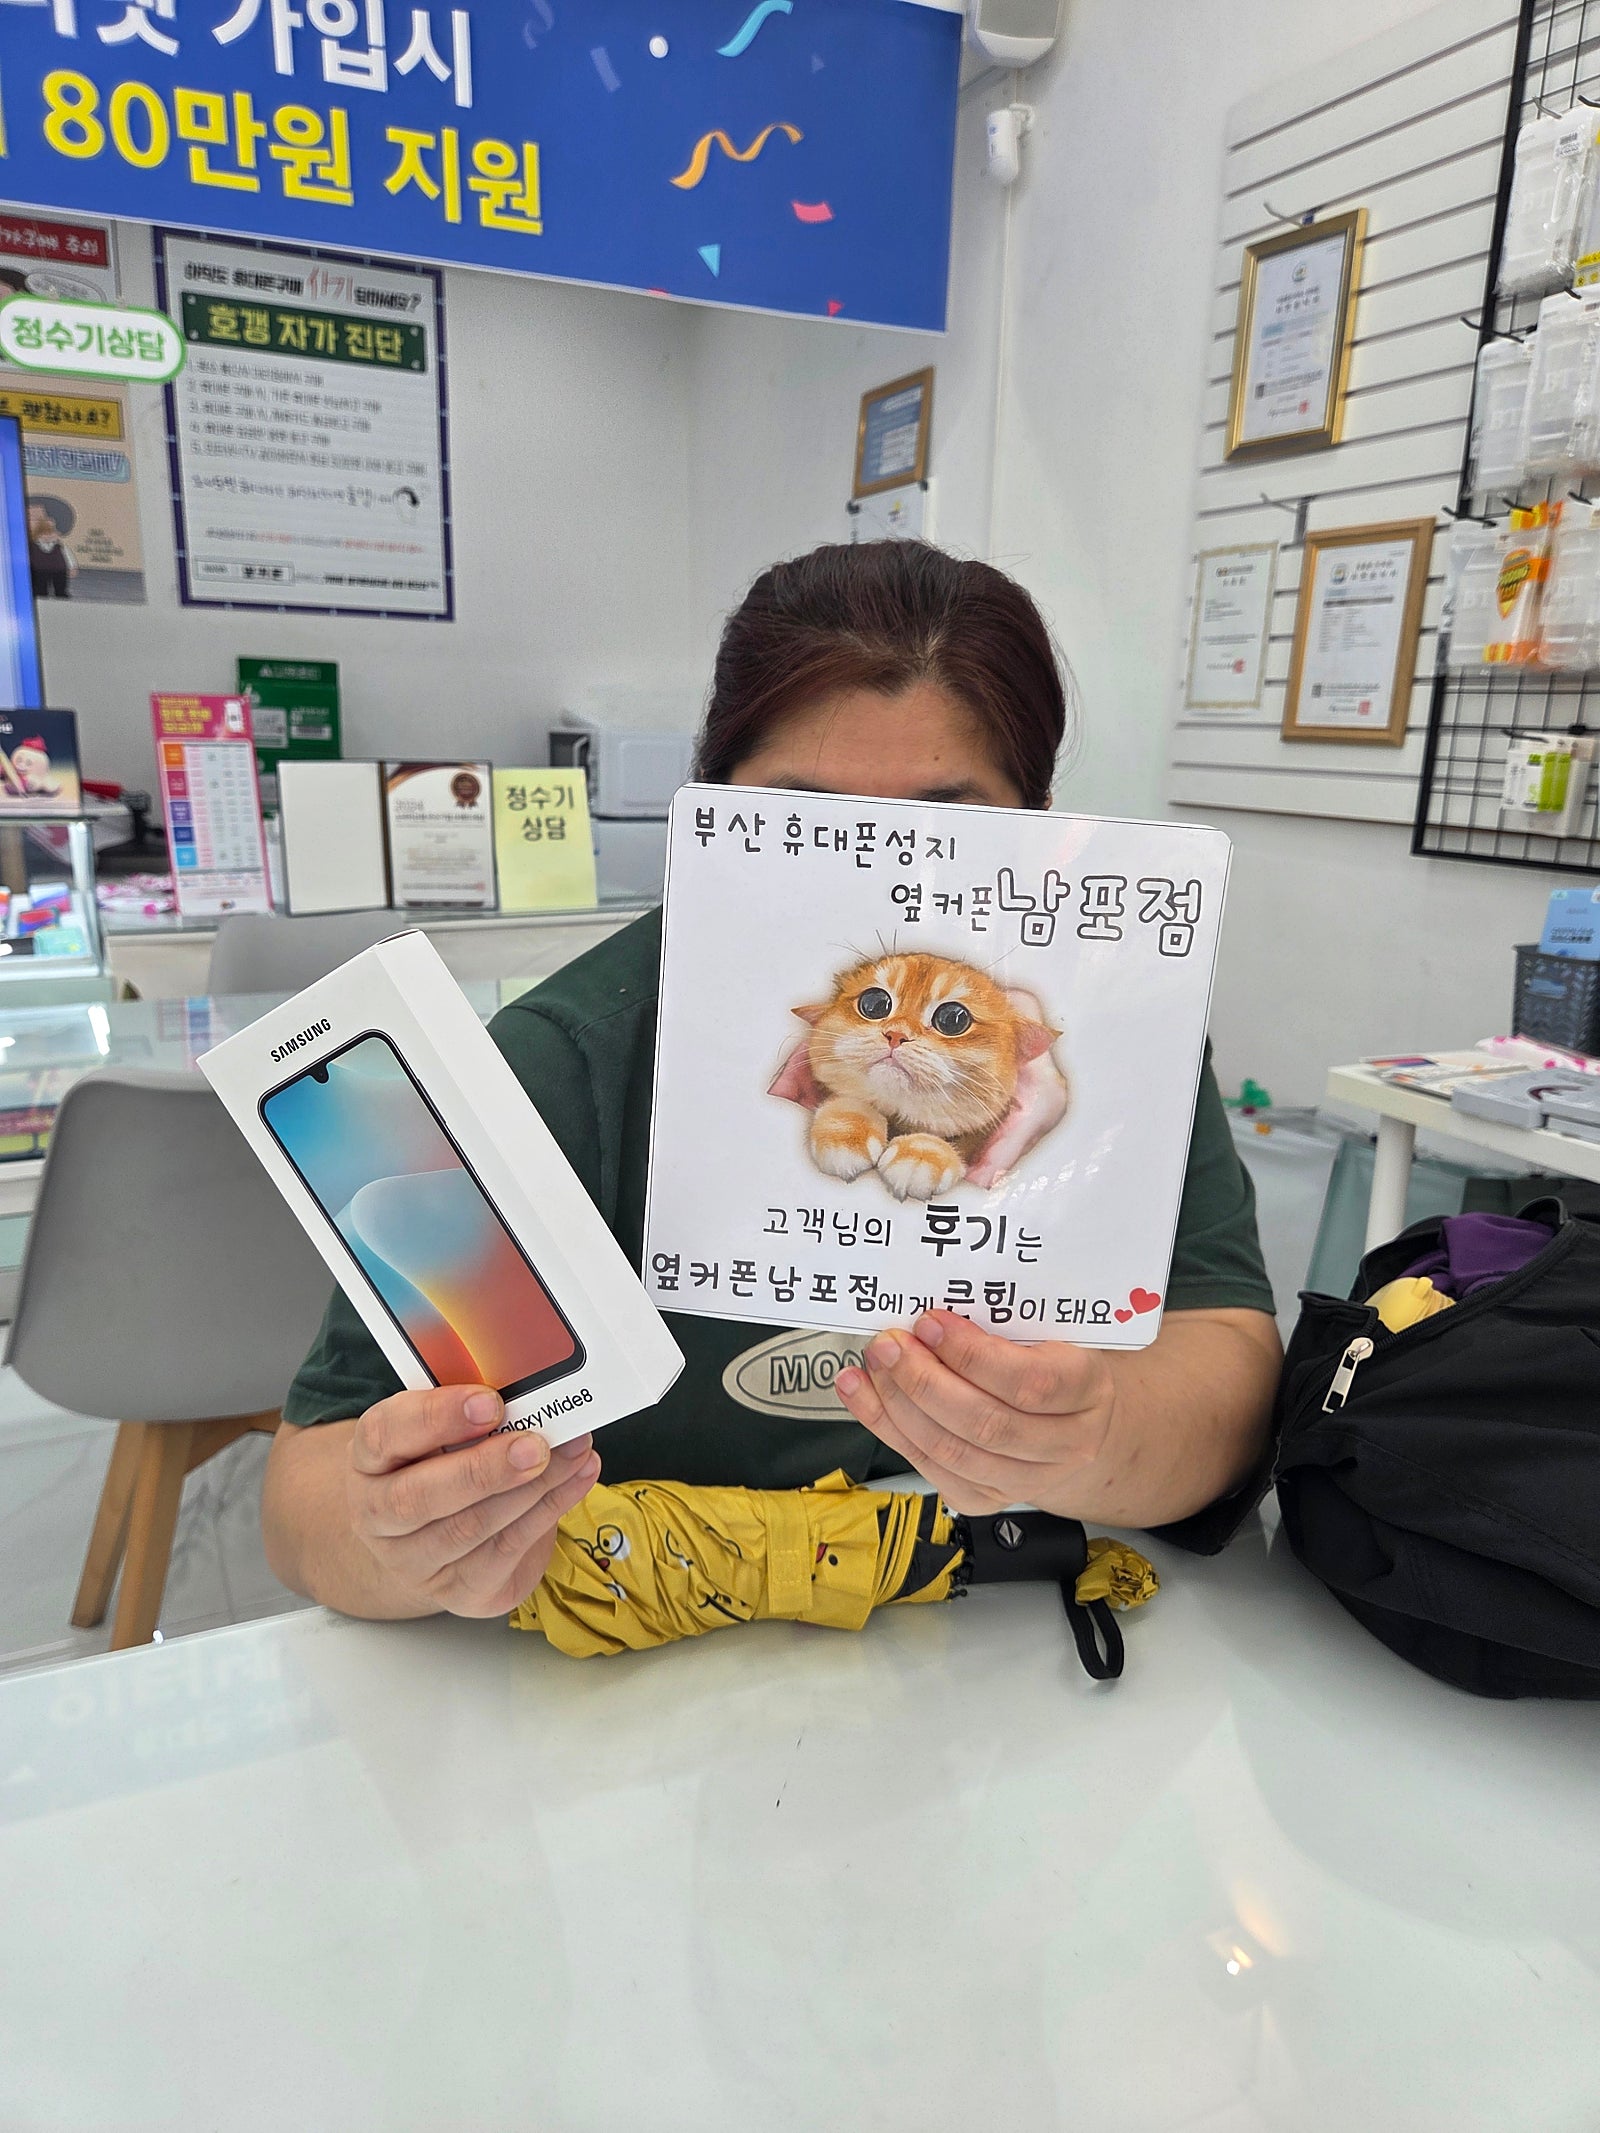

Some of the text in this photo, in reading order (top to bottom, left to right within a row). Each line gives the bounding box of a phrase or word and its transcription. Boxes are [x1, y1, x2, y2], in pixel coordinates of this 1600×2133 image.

[212, 0, 472, 107] 가입시
[43, 70, 544, 234] 80만원 지원
[11, 316, 166, 362] 정수기상담
[207, 303, 404, 363] 호갱 자가 진단
[506, 785, 575, 812] 정수기
[522, 815, 567, 842] 상담
[695, 806, 956, 868] 부산 휴대폰성지
[270, 1018, 331, 1062] SAMSUNG
[763, 1204, 1042, 1263] 고객님의 후기는
[1055, 1298, 1112, 1324] 돼요
[540, 1388, 593, 1419] Wide8
